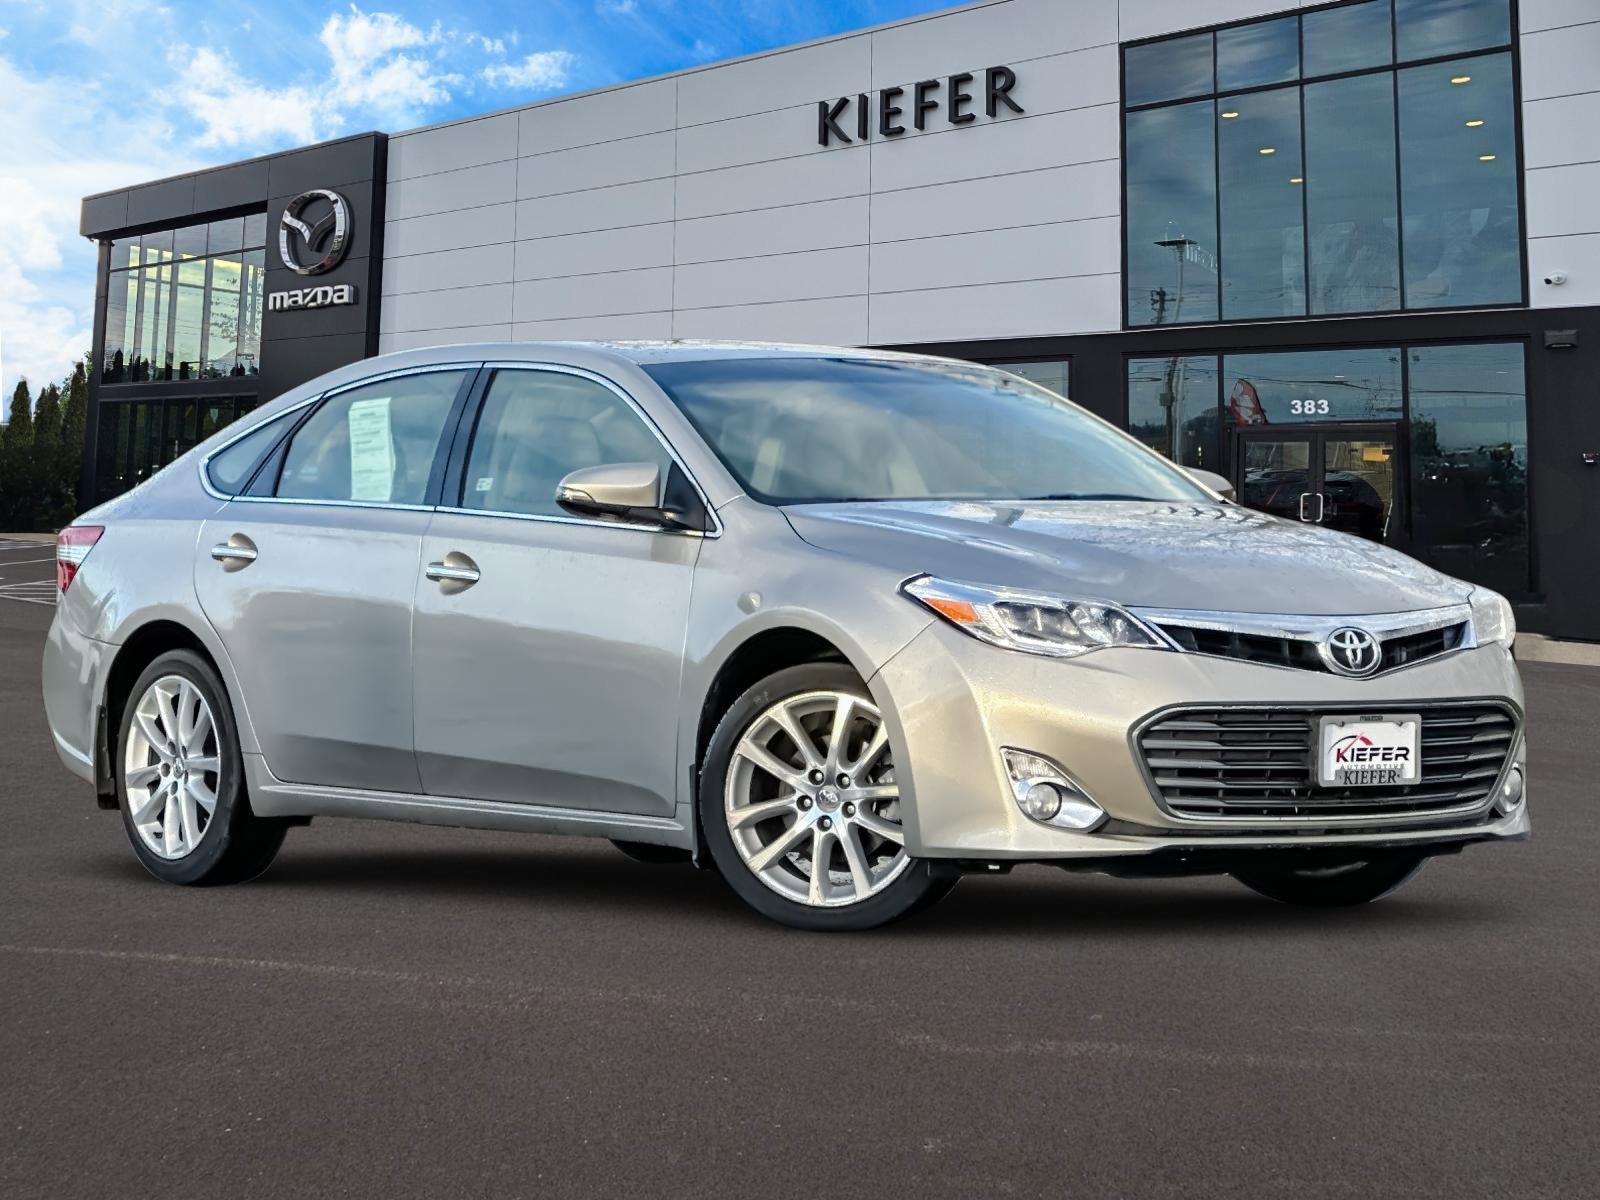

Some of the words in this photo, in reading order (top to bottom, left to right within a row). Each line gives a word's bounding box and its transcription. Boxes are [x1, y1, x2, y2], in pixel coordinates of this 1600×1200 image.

[818, 65, 1024, 147] KIEFER
[1290, 399, 1330, 415] 383
[1336, 746, 1410, 763] KIEFER
[1343, 769, 1397, 785] KIEFER
